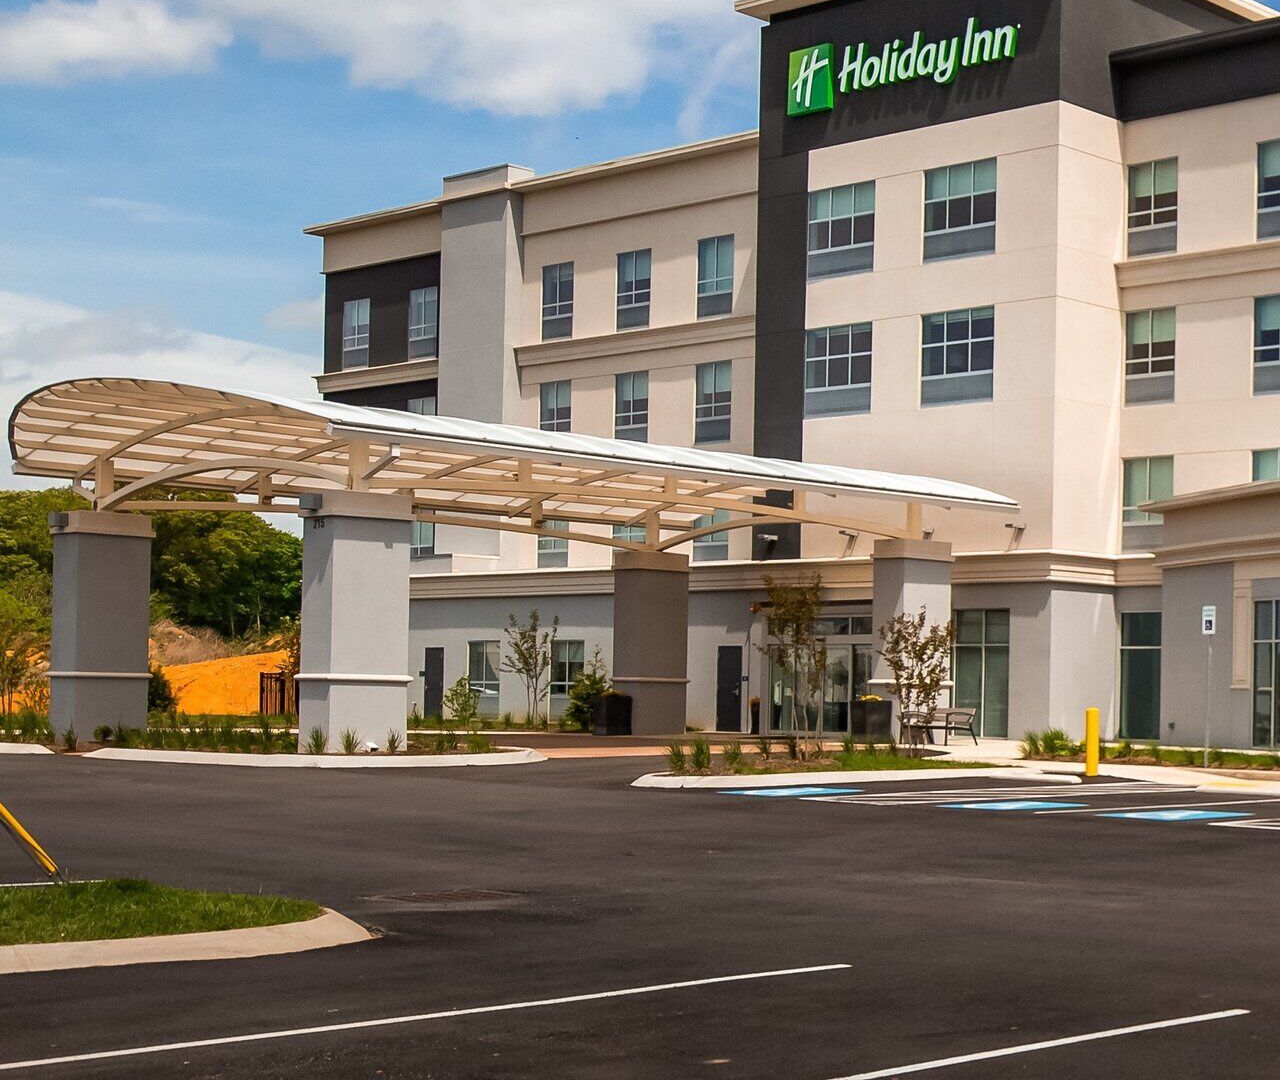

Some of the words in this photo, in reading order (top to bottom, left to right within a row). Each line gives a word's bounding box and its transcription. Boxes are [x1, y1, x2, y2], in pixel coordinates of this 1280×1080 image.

[838, 31, 962, 93] Holiday
[962, 17, 1018, 67] Inn
[313, 519, 325, 529] 215
